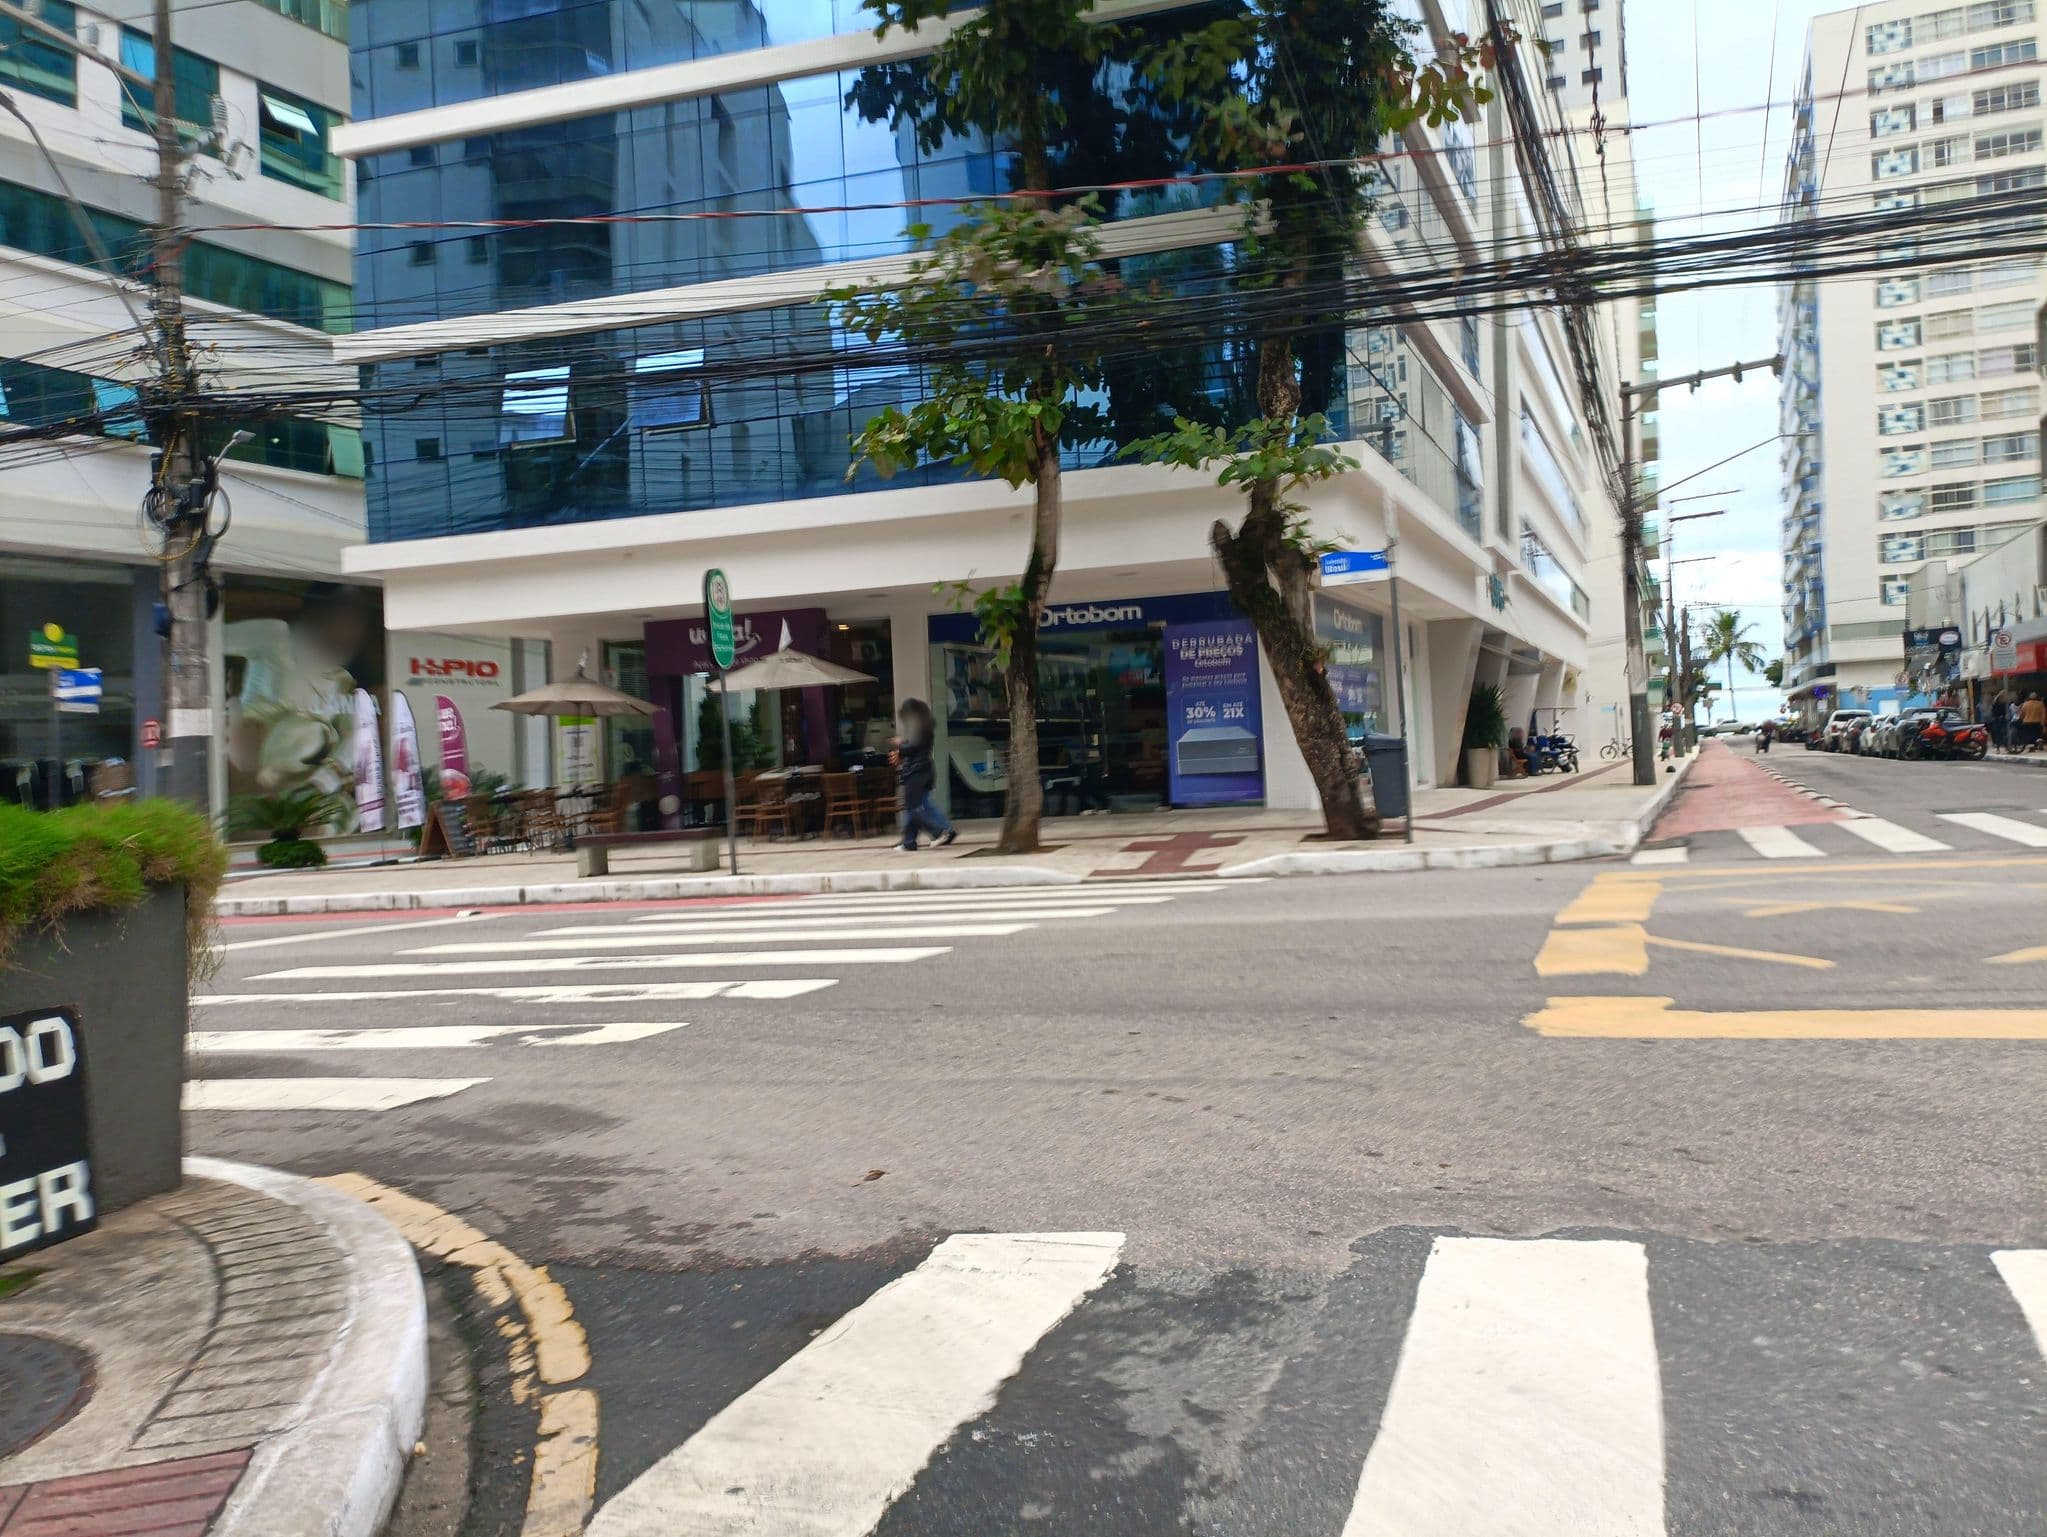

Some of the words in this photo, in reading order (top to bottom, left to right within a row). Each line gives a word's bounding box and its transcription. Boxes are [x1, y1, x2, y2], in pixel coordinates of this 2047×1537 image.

[1040, 604, 1142, 627] Ortobom
[1180, 647, 1196, 660] DE
[1186, 706, 1216, 719] 30%
[1223, 707, 1245, 718] 21X
